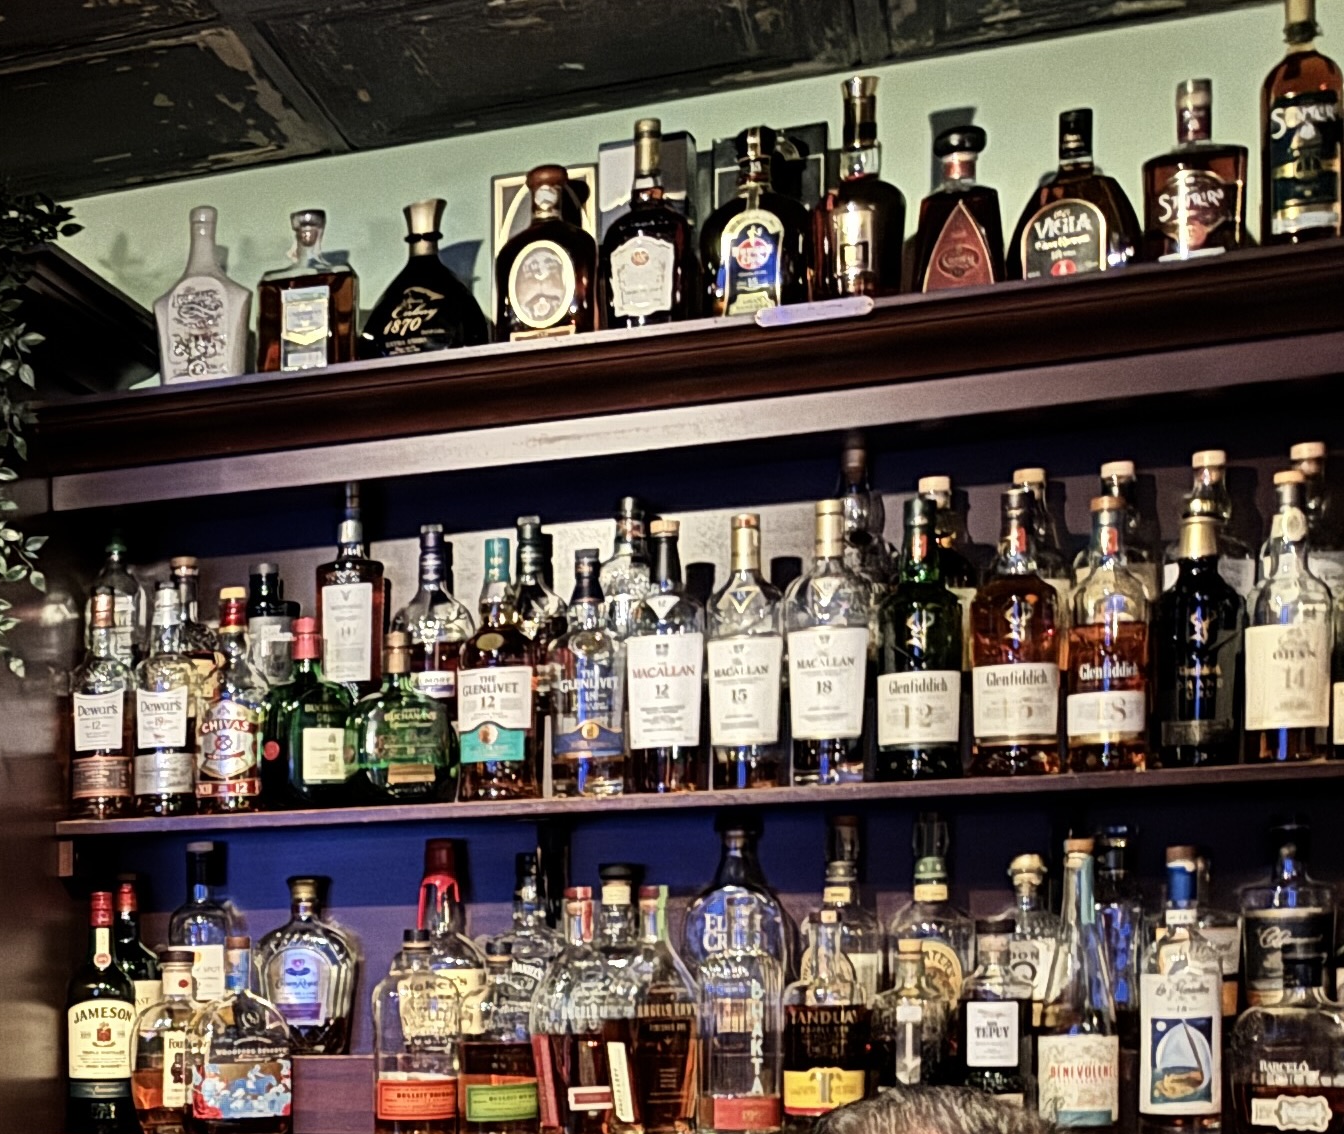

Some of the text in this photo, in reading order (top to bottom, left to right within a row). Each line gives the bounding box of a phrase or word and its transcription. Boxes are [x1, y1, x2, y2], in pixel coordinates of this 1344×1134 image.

[383, 317, 422, 337] 1870
[796, 657, 855, 670] MACALLAN
[632, 665, 696, 679] MACALLAN
[714, 664, 768, 678] MACALLAN
[986, 668, 1048, 687] Glenfiddich
[1079, 661, 1139, 681] Glenfiddich
[480, 675, 496, 684] THE
[889, 677, 948, 695] Glenfiddich
[462, 682, 519, 695] GLENLIVET
[655, 684, 669, 696] 12
[816, 680, 833, 694] 18
[731, 688, 748, 703] 15
[141, 701, 182, 712] Dewar's
[480, 696, 495, 710] 12
[78, 705, 118, 717] Dewar's
[91, 721, 101, 730] 12
[201, 719, 250, 733] CHIVAS
[235, 782, 248, 794] 12
[73, 1007, 132, 1024] JAMESON
[975, 1027, 1009, 1038] TEPUY
